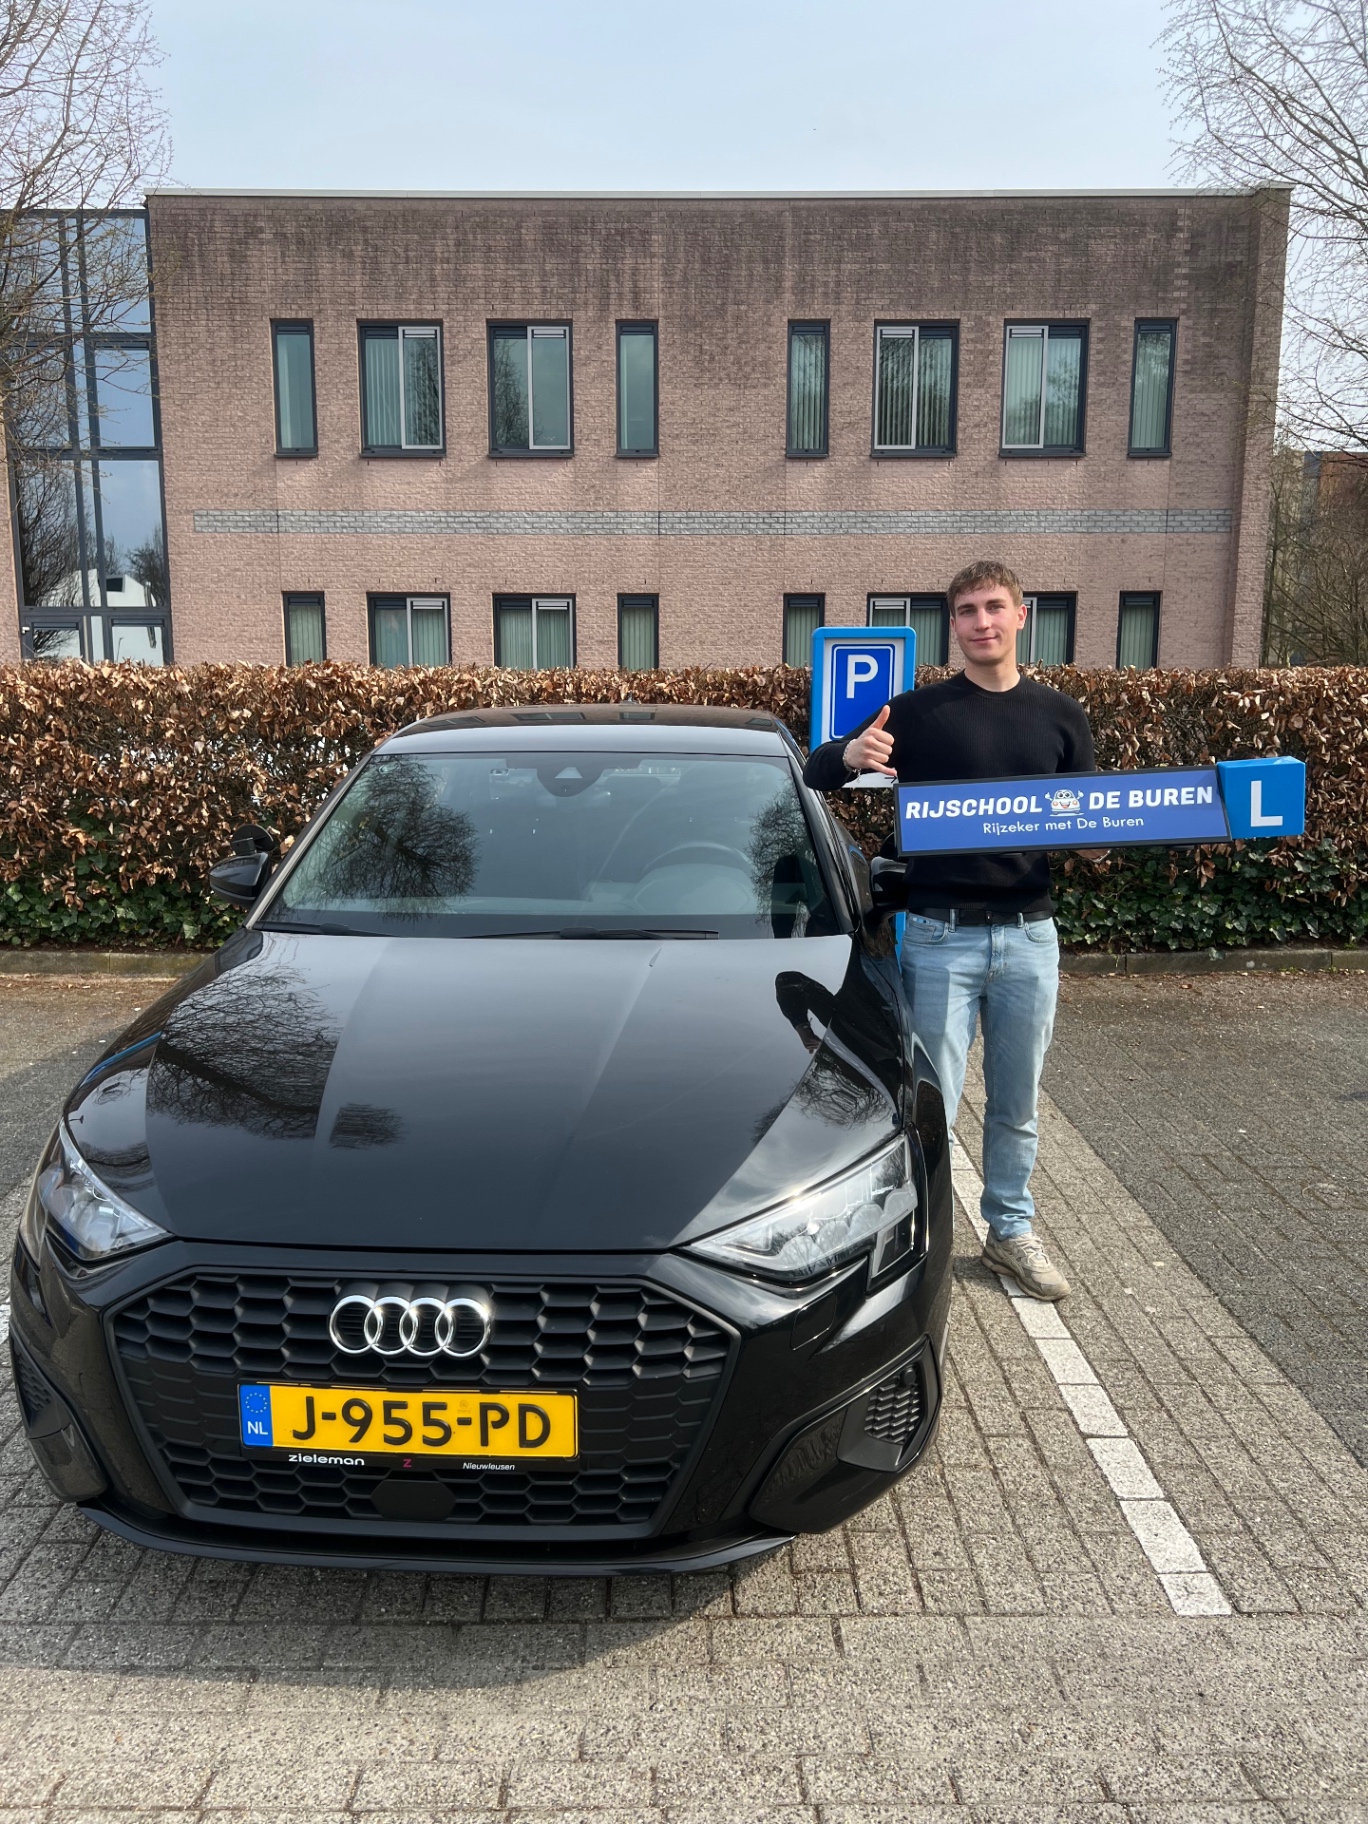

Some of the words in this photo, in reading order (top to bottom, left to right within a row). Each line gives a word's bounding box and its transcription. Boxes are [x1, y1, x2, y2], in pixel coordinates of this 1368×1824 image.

[846, 654, 879, 699] P
[905, 795, 1043, 819] RIJSCHOOL
[1088, 791, 1121, 810] DE
[1128, 786, 1213, 808] BUREN
[1250, 780, 1284, 828] L
[983, 821, 1040, 836] Rijzeker
[1045, 820, 1072, 831] met
[1076, 817, 1097, 829] De
[1102, 816, 1144, 828] Buren
[247, 1420, 269, 1435] NL
[292, 1396, 551, 1449] J-955-PD
[288, 1453, 365, 1466] zieleman
